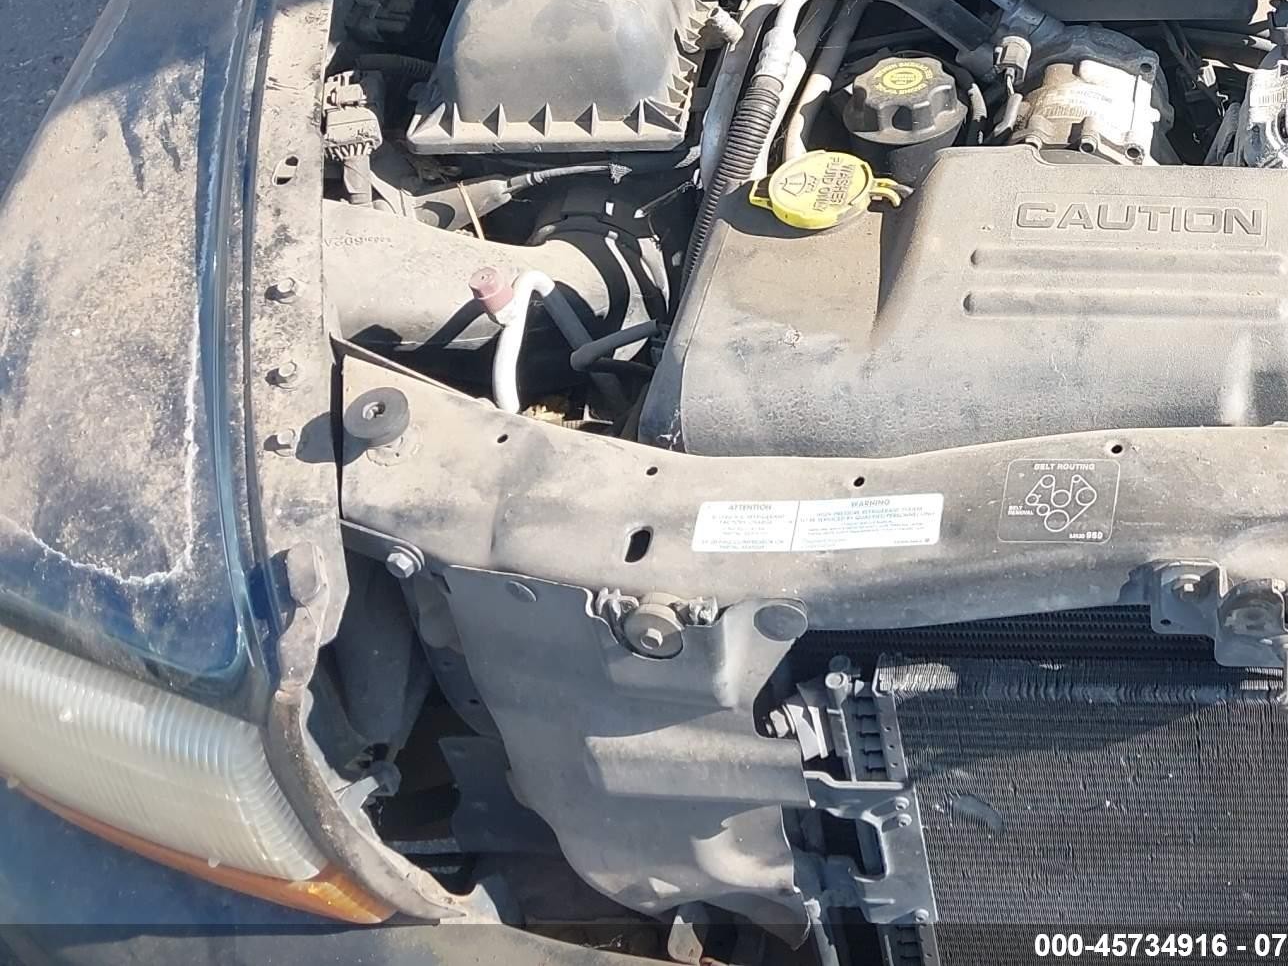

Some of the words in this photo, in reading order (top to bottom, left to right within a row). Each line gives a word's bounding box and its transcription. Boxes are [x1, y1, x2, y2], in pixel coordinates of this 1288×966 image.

[828, 163, 857, 208] WASHER
[812, 187, 831, 212] ONLY
[1015, 201, 1264, 236] CAUTION
[1034, 463, 1055, 471] BELT
[1056, 463, 1096, 471] ROUTING
[727, 503, 773, 512] ATTENTION
[850, 498, 892, 508] WARNING
